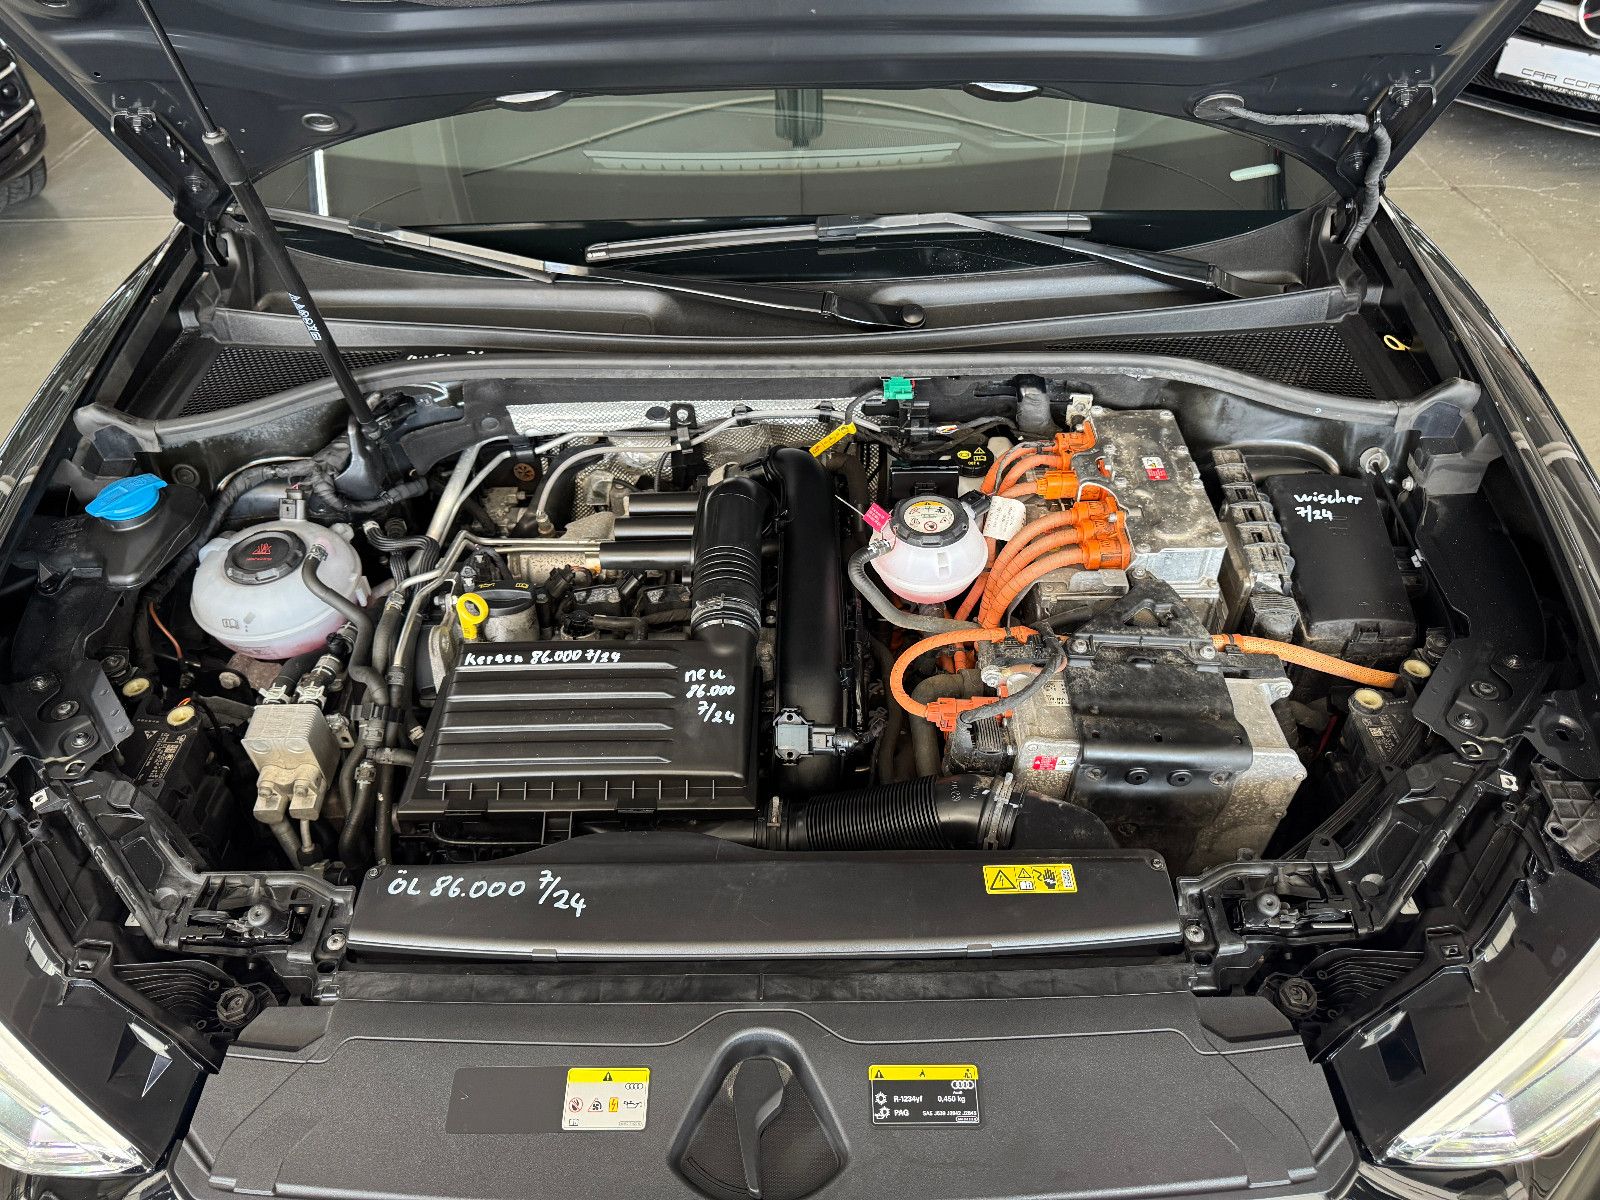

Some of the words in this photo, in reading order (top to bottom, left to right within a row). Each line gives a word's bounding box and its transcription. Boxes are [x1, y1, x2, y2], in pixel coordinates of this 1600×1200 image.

[1521, 68, 1557, 82] CAR
[1294, 504, 1333, 522] 7/24
[530, 650, 582, 664] 86.000
[584, 649, 621, 664] 7/24
[684, 668, 726, 683] neu
[697, 700, 735, 725] 7/24
[387, 869, 421, 895] ÖL
[429, 875, 526, 899] 86.000
[538, 869, 587, 918] 7/24
[893, 1095, 923, 1104] R-1234yf
[937, 1095, 956, 1103] 0,450
[957, 1095, 966, 1104] kg
[893, 1109, 910, 1117] PAG
